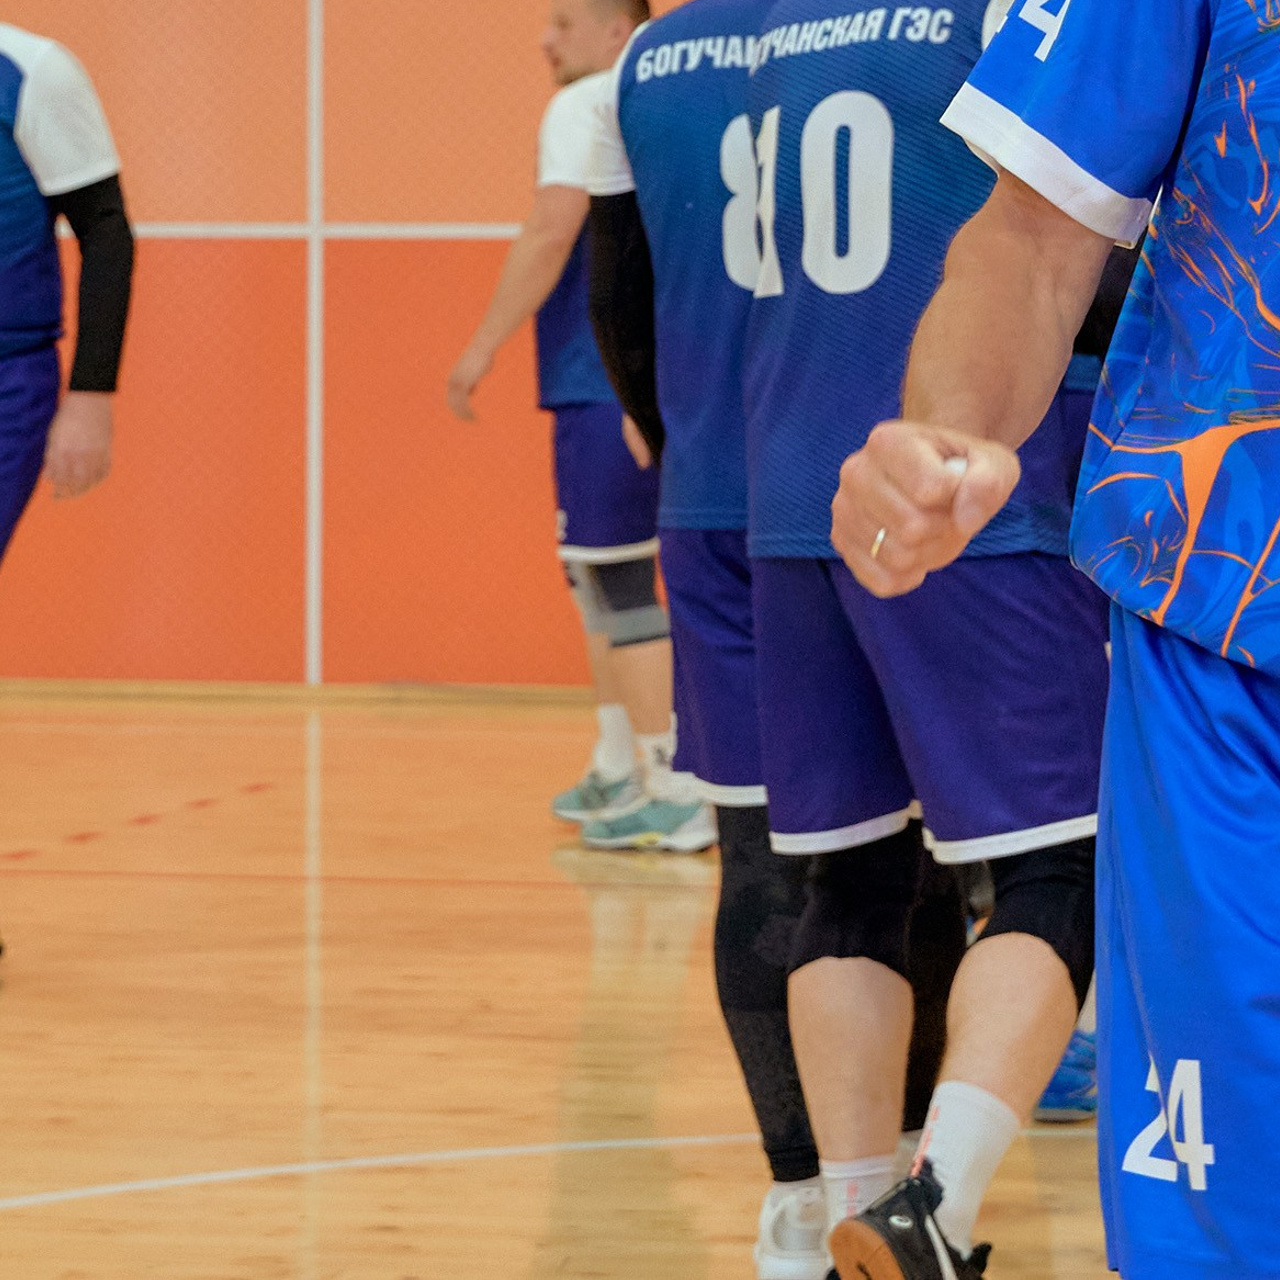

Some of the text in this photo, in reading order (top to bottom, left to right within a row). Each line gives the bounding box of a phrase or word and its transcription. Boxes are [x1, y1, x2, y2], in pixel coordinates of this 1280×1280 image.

[886, 6, 954, 44] ГЭС
[753, 89, 896, 300] 10
[1121, 1054, 1216, 1192] 24
